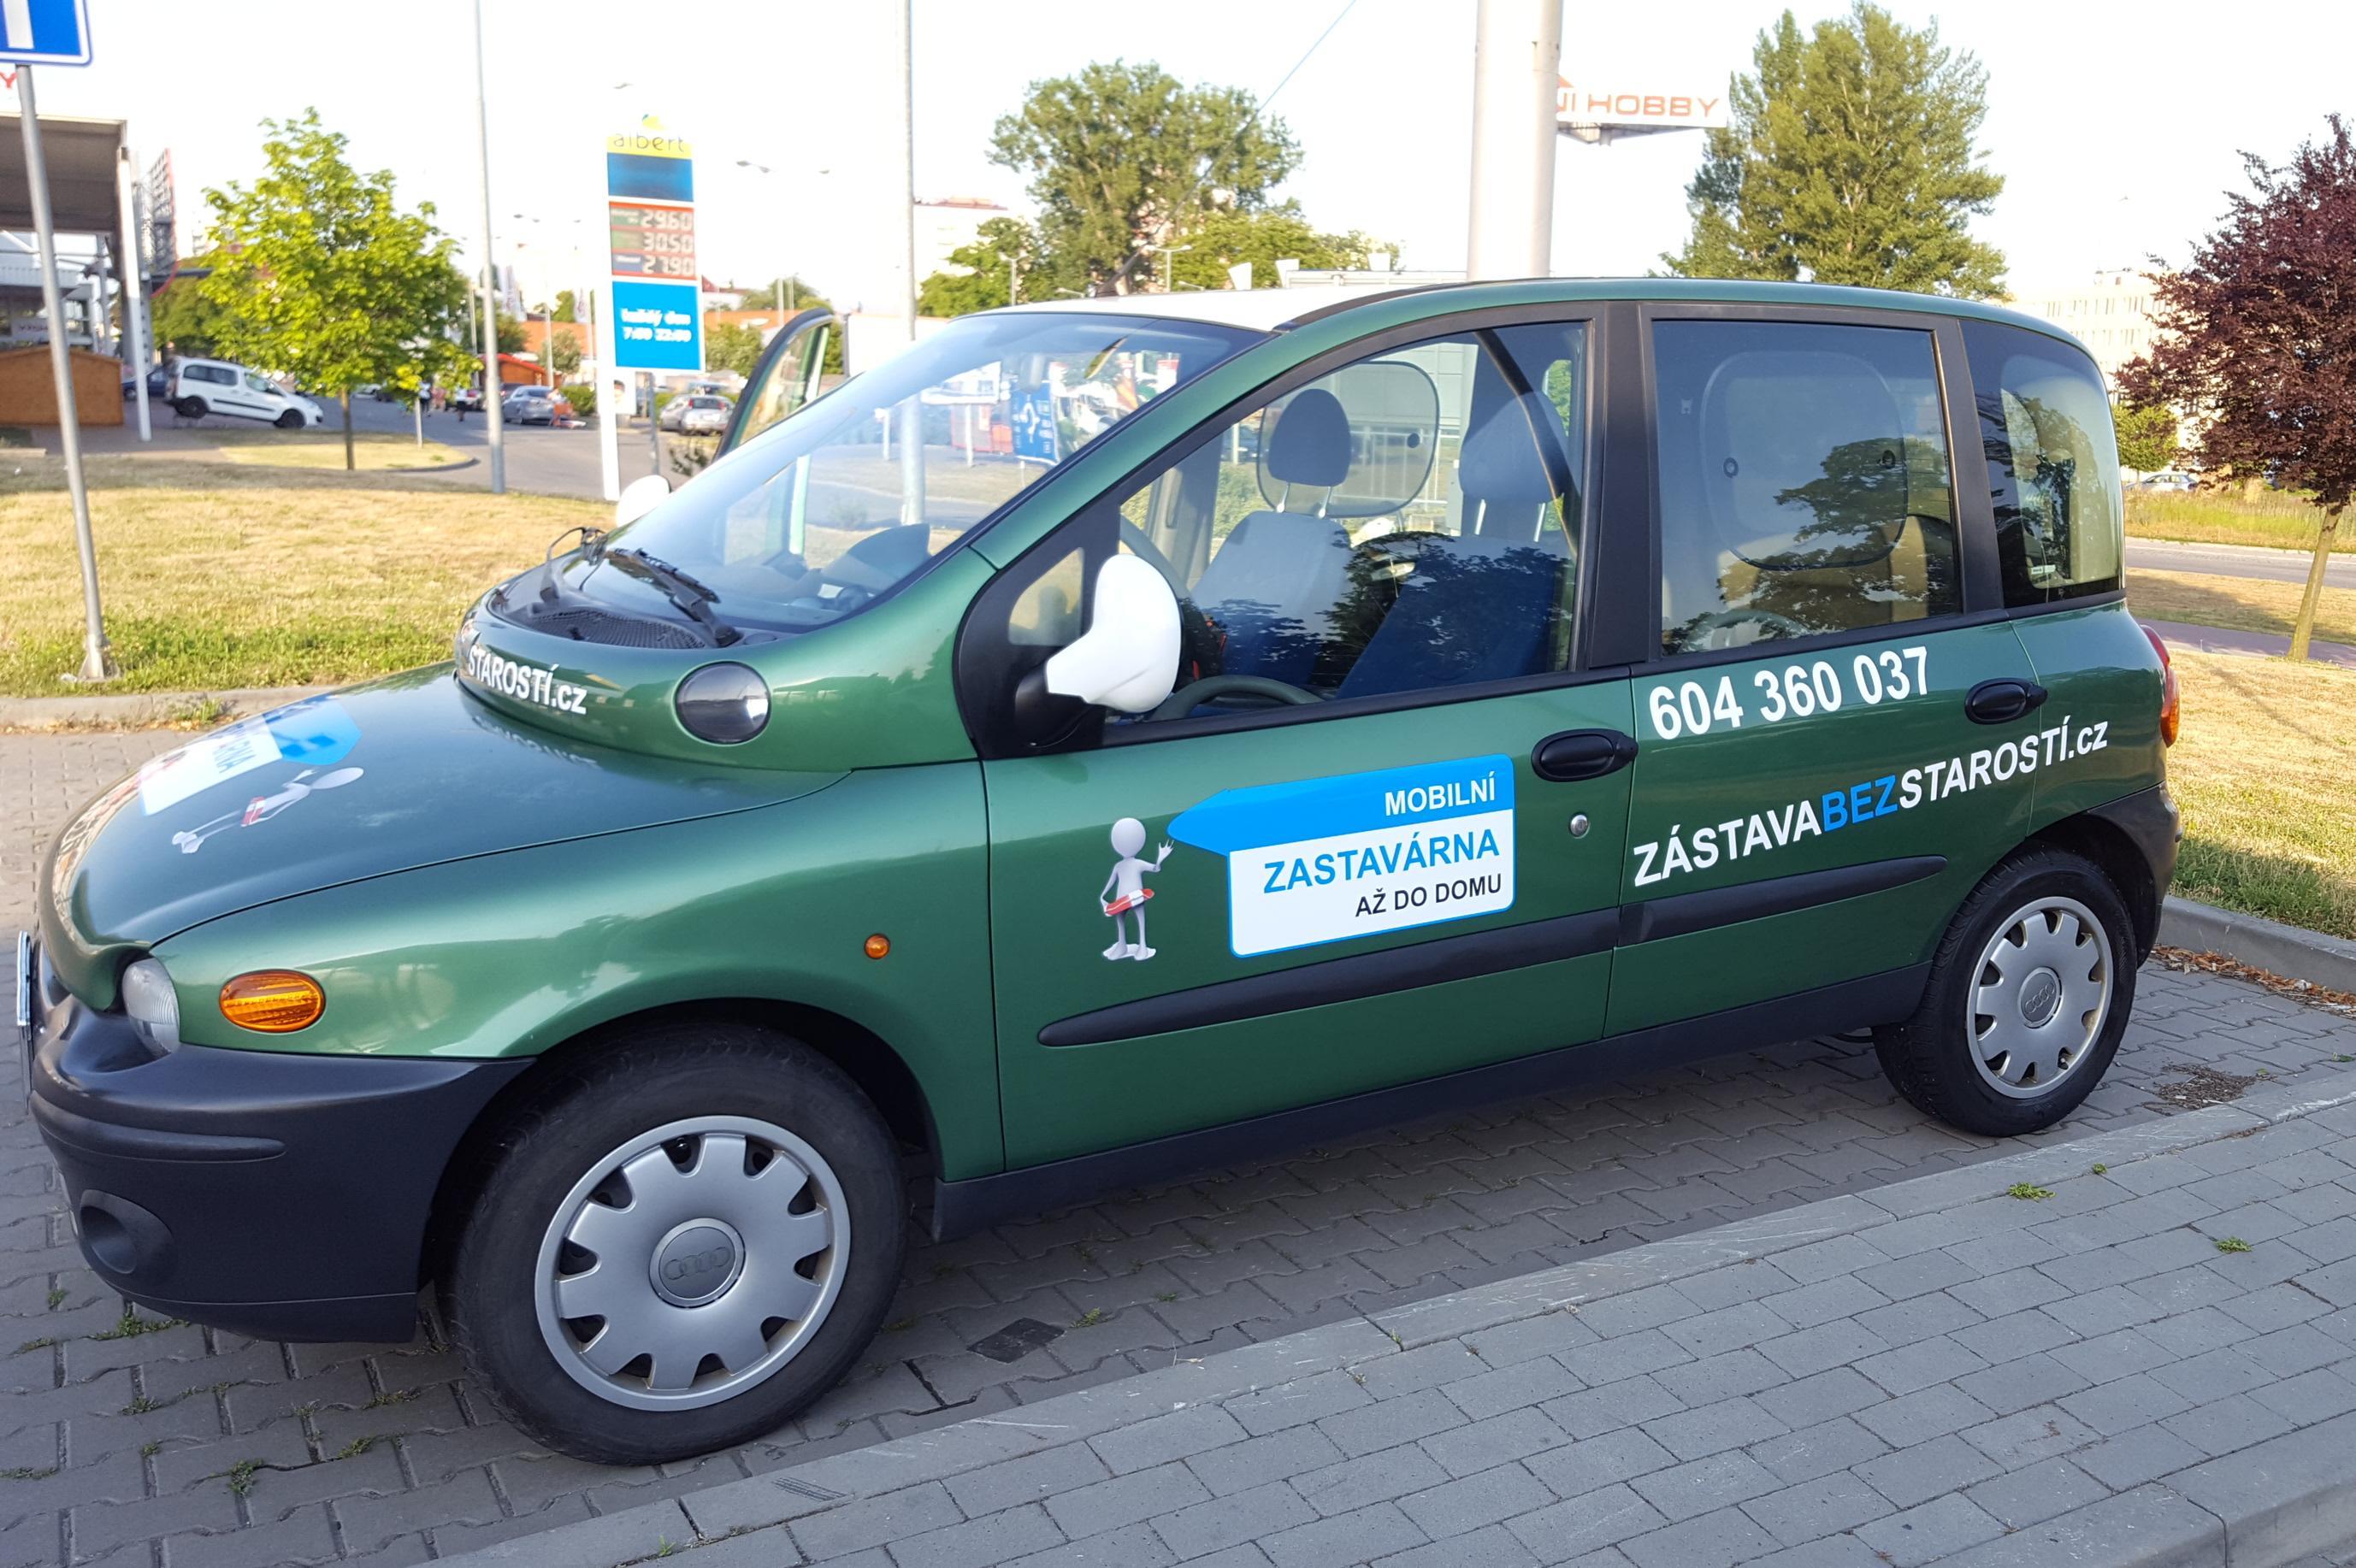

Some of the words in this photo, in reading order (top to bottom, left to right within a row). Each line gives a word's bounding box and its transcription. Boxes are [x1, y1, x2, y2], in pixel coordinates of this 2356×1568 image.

[1587, 94, 1719, 117] HOBBY
[614, 132, 685, 152] albert
[468, 645, 588, 715] STAROSTÍ.cz
[1649, 675, 1745, 740] 604
[1754, 661, 1843, 722] 360
[1853, 645, 1928, 704] 037
[1385, 770, 1496, 816] MOBILNÍ
[1263, 831, 1500, 894] ZASTAVÁRNA
[1355, 887, 1386, 917] AŽ
[1394, 886, 1427, 911] DO
[1435, 873, 1502, 904] DOMU
